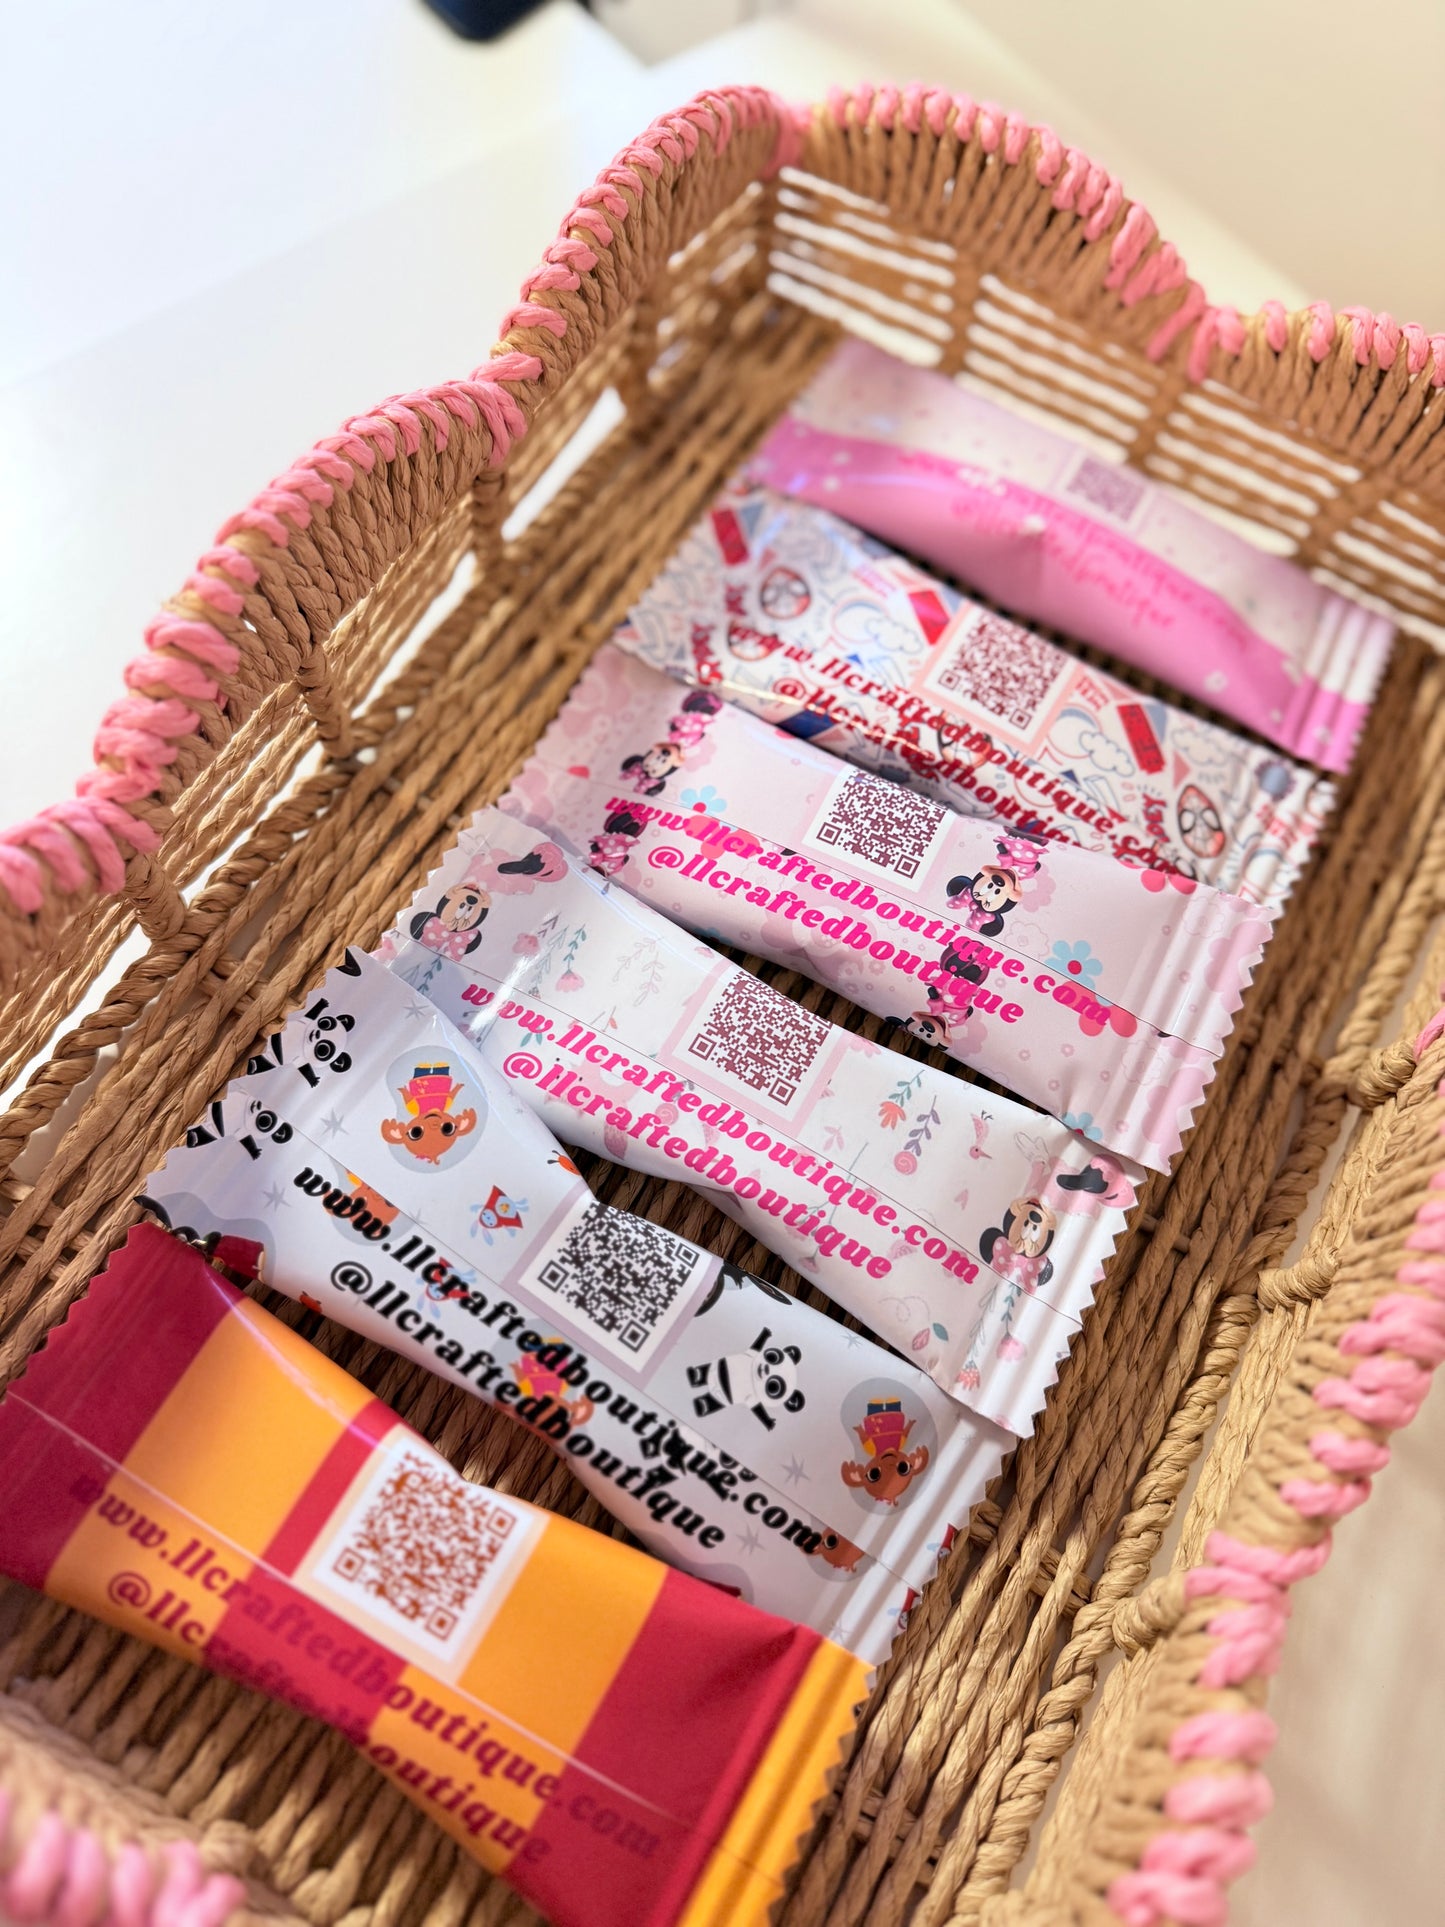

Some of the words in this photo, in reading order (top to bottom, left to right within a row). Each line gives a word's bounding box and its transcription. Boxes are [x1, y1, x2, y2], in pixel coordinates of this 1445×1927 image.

[604, 797, 1111, 1026] www.llcraftedboutique.com
[648, 845, 1025, 1024] @llcraftedboutique
[503, 1052, 893, 1280] @llcraftedboutique
[294, 1166, 823, 1555] www.llcraftedboutique.com
[331, 1261, 725, 1550] @llcraftedboutique
